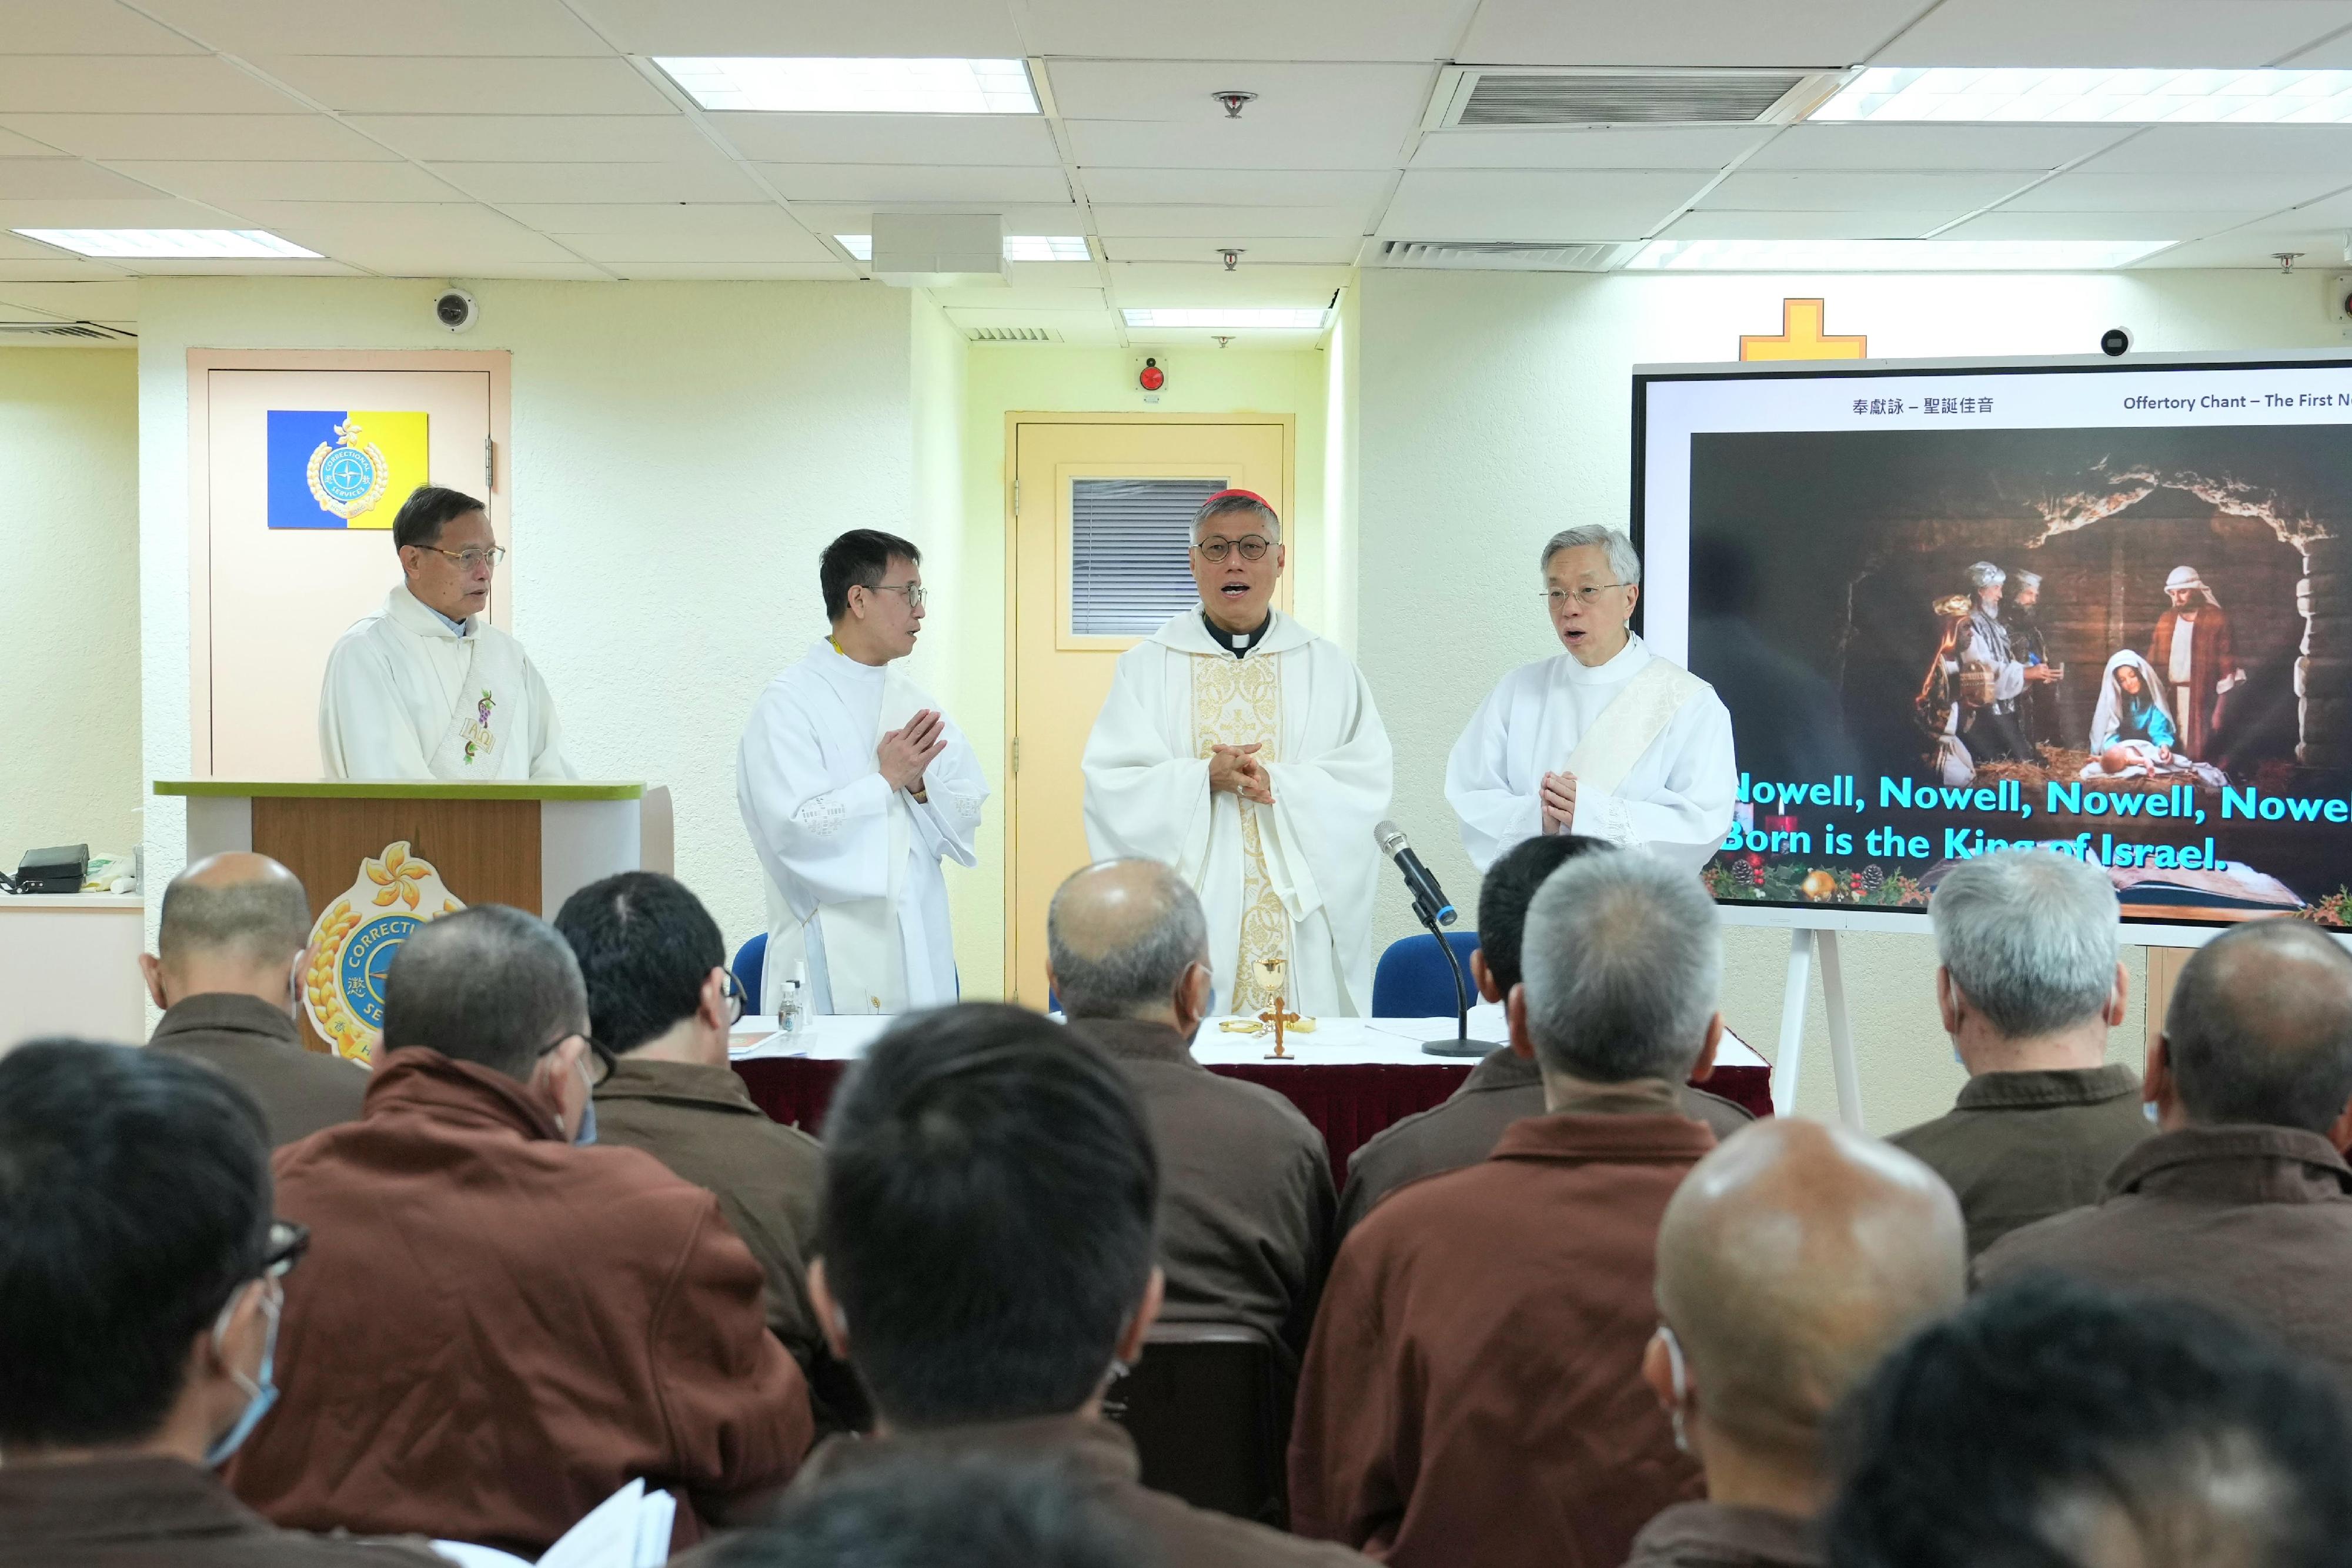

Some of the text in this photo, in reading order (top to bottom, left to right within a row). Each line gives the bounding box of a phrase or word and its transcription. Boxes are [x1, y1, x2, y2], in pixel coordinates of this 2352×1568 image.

[1853, 398, 1904, 415] 奉獻詠
[1923, 396, 1994, 414] 聖誕佳音
[2124, 396, 2196, 412] Offertory
[2200, 394, 2246, 408] Chant
[2264, 393, 2294, 407] The
[2300, 393, 2333, 406] First
[325, 451, 370, 472] CORRECTIONAL
[332, 486, 365, 497] SERVICES
[1880, 776, 2032, 818] Nowell,
[2047, 781, 2205, 824] Nowell,
[2221, 787, 2352, 823] Nowe
[1719, 821, 1810, 854] Born
[1826, 824, 1852, 855] is
[1865, 826, 1929, 858] the
[2049, 833, 2091, 862] of
[2100, 834, 2227, 870] Israel.
[347, 977, 366, 998] 懲
